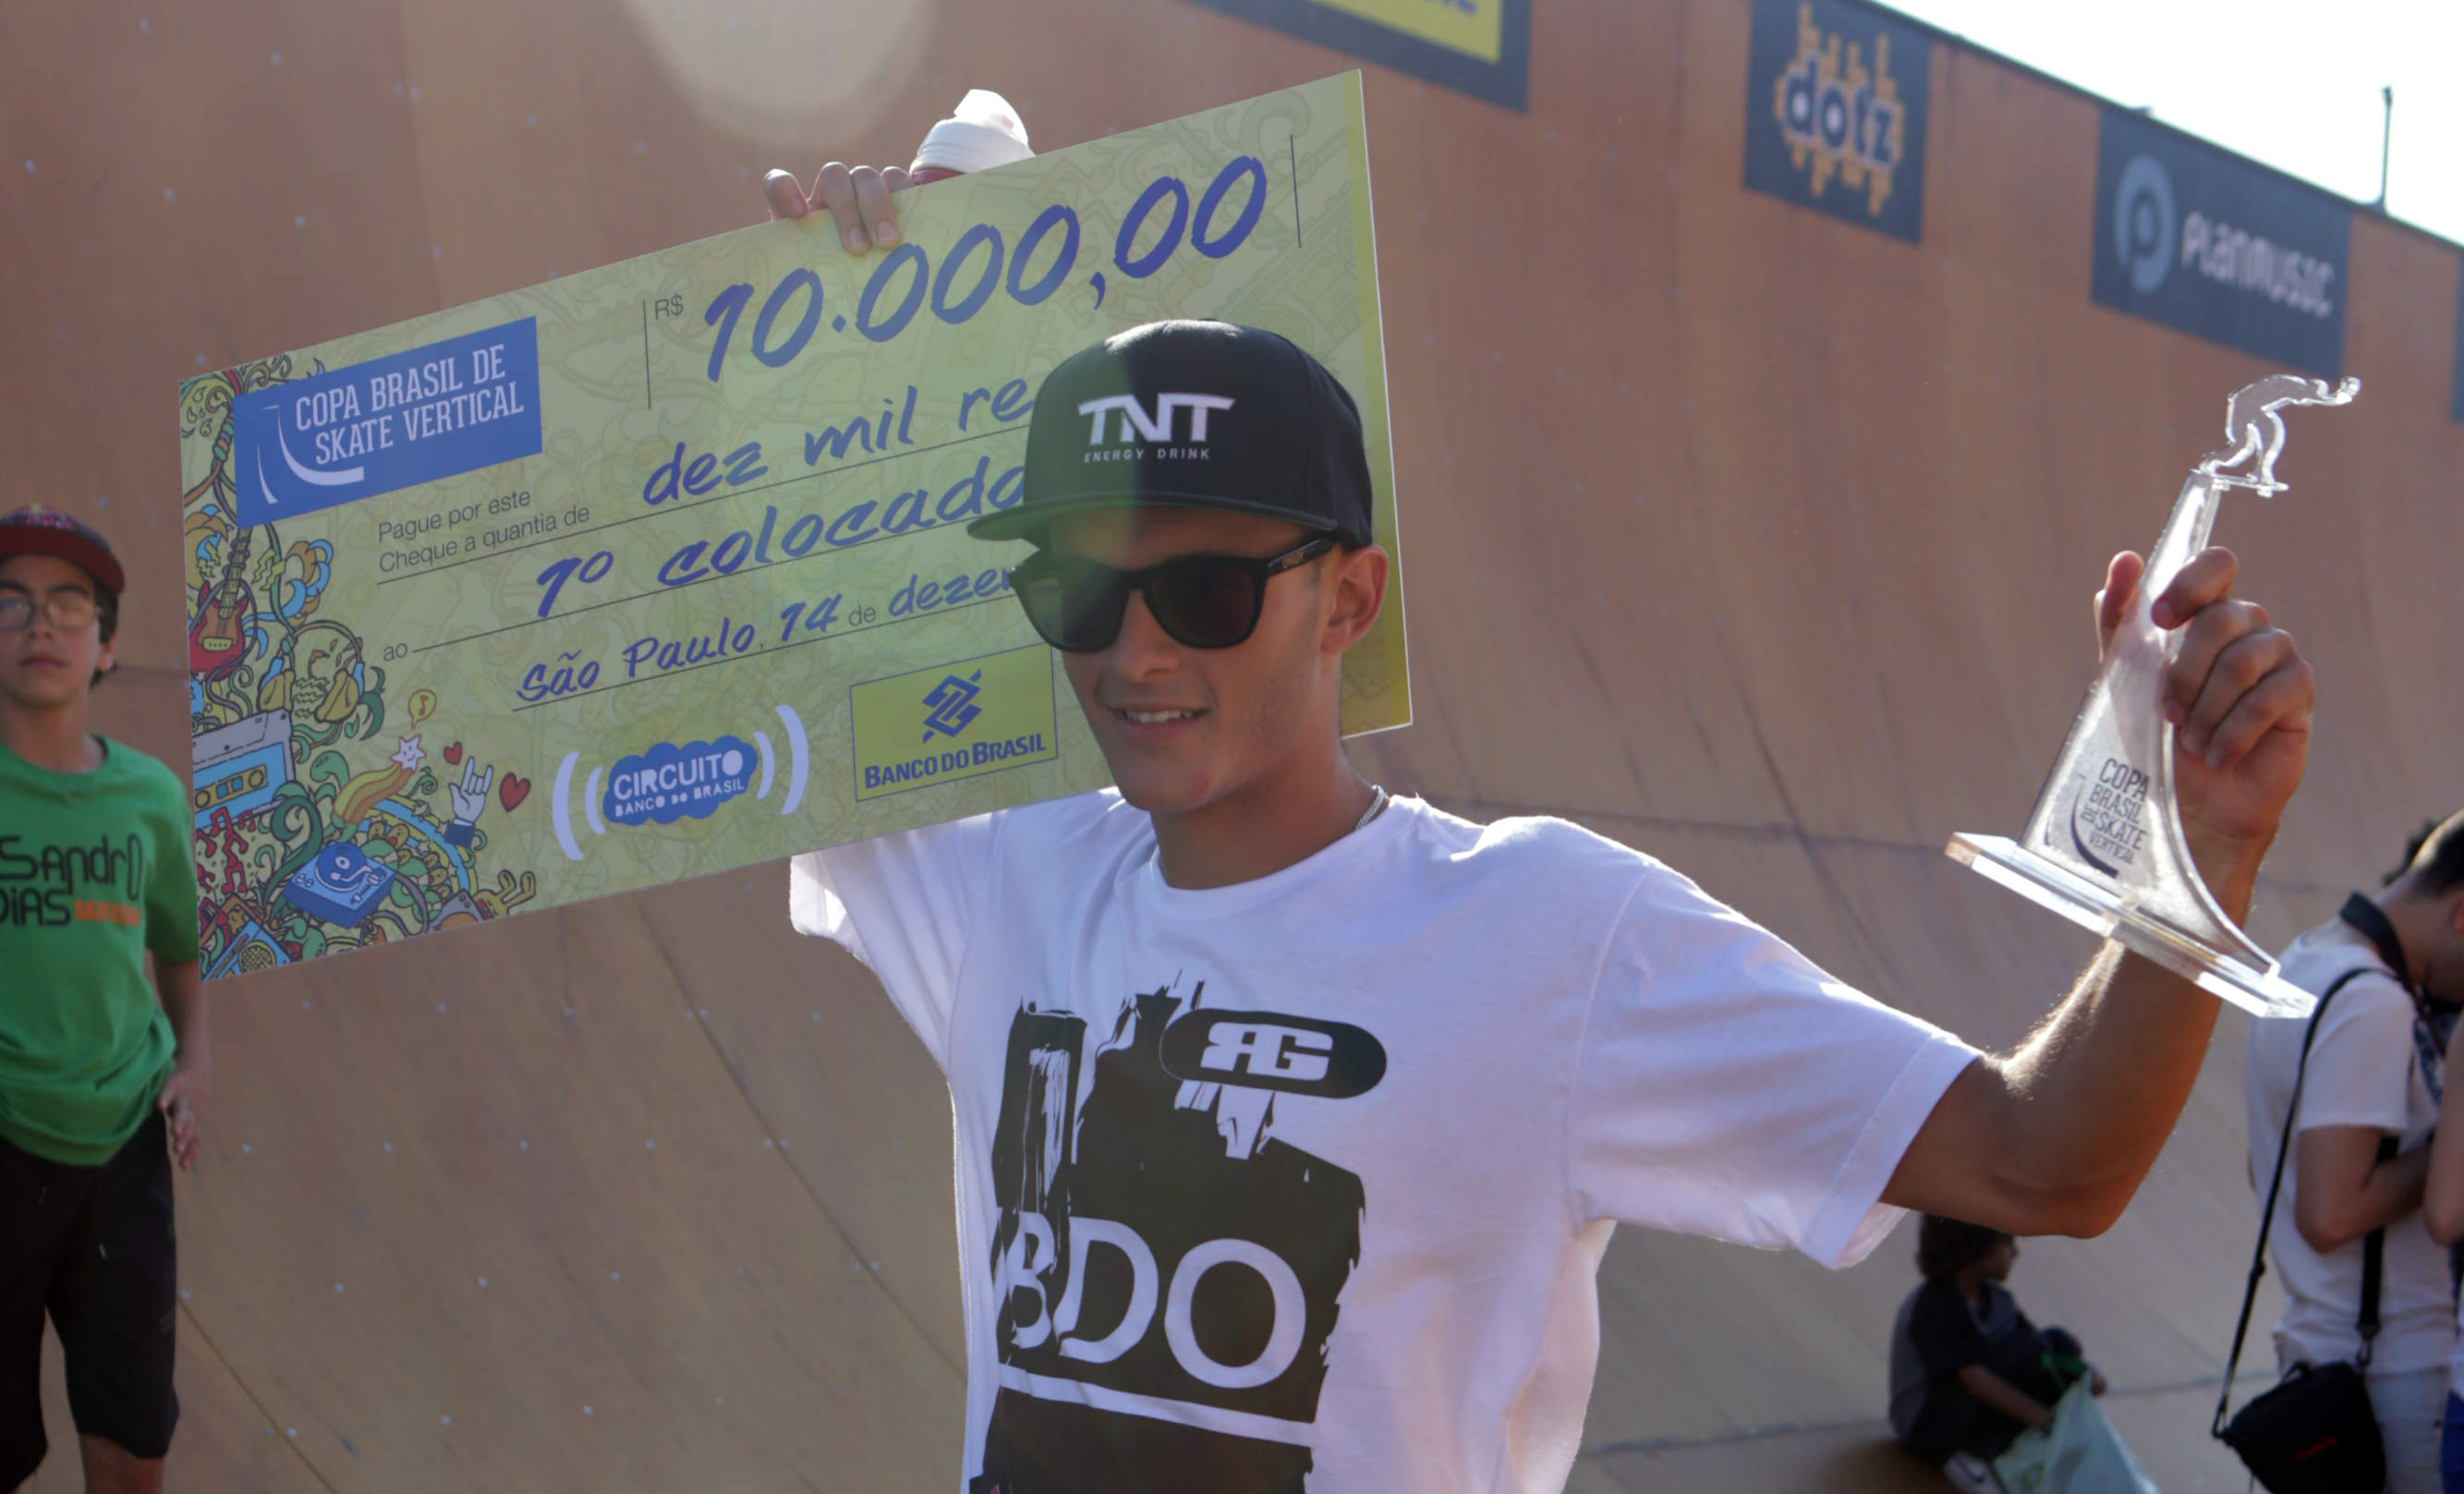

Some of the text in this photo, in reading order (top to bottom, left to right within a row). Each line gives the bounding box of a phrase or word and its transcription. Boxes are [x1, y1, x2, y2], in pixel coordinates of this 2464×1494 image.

[654, 155, 1267, 383] R$ 10.000,00
[295, 343, 506, 431] COPA BRASIL DE
[315, 381, 525, 465] SKATE VERTICAL
[643, 441, 769, 506] dez
[804, 385, 916, 467] mil
[1077, 392, 1236, 446] TNT
[1083, 448, 1210, 463] ENERGY DRINK
[378, 490, 532, 543] Pague por este
[379, 504, 591, 573] Cheque a quantia de
[382, 642, 408, 662] ao
[516, 649, 601, 702] São
[780, 592, 843, 642] 14
[848, 603, 877, 627] de
[613, 749, 744, 801] CIRCUITO
[614, 778, 745, 818] BANCO DO BRASIL
[2098, 757, 2150, 802] COPA
[2089, 782, 2144, 825] BRASIL
[2094, 809, 2147, 851] SKATE
